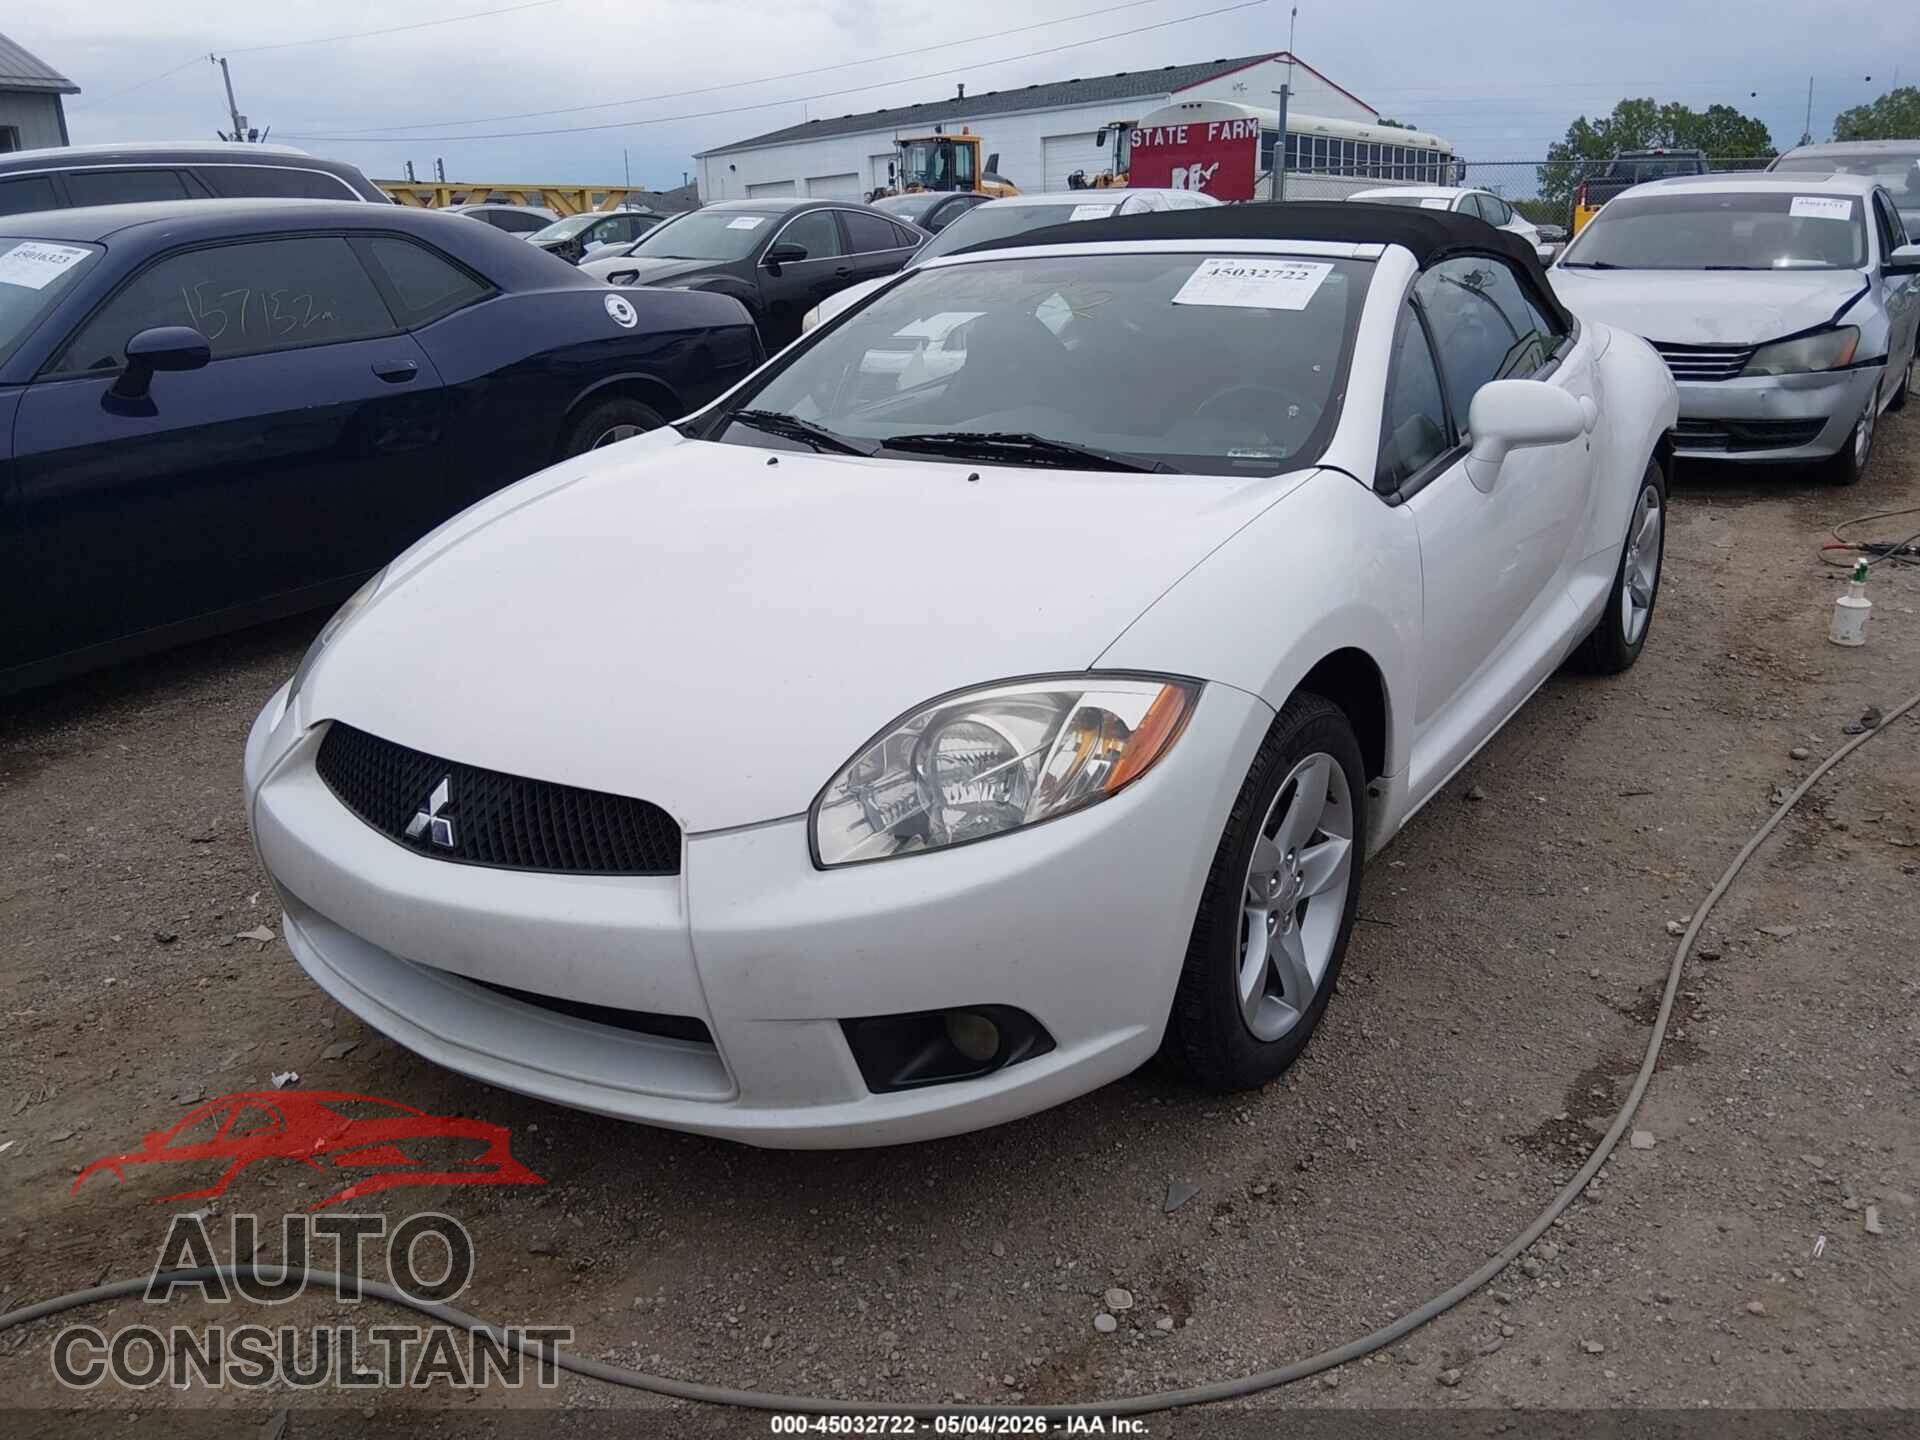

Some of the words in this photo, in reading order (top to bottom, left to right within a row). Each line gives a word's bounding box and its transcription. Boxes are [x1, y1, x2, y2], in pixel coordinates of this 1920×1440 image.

[1131, 126, 1189, 148] STATE
[1207, 119, 1257, 141] FARM
[1207, 267, 1309, 281] 45032722
